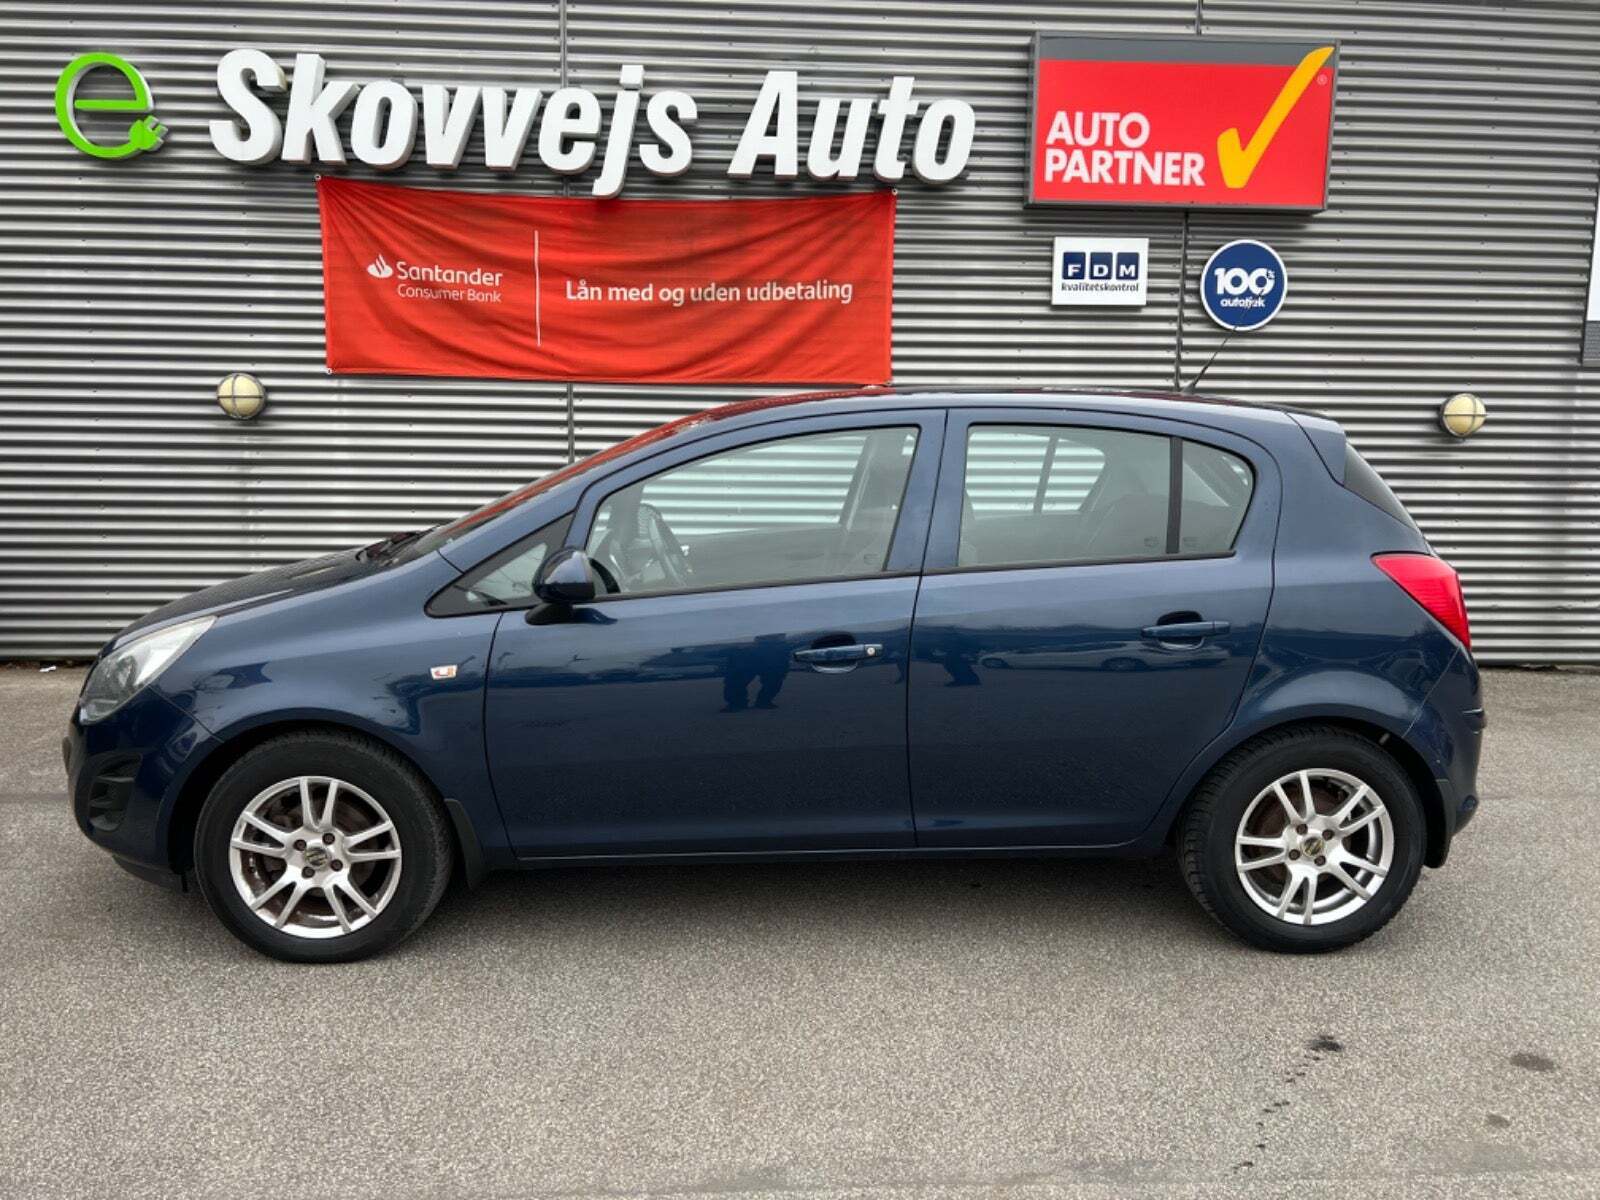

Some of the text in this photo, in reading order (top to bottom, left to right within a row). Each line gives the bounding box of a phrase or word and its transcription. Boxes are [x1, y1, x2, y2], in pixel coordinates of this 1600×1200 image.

[209, 48, 977, 197] Skovvejs Auto
[1046, 110, 1151, 148] AUTO
[1045, 148, 1206, 186] PARTNER
[396, 261, 503, 287] Santander
[1061, 282, 1139, 292] kvalitetskontrol
[397, 283, 502, 303] Consumer Bank
[565, 279, 853, 307] Lån med og uden udbetaling
